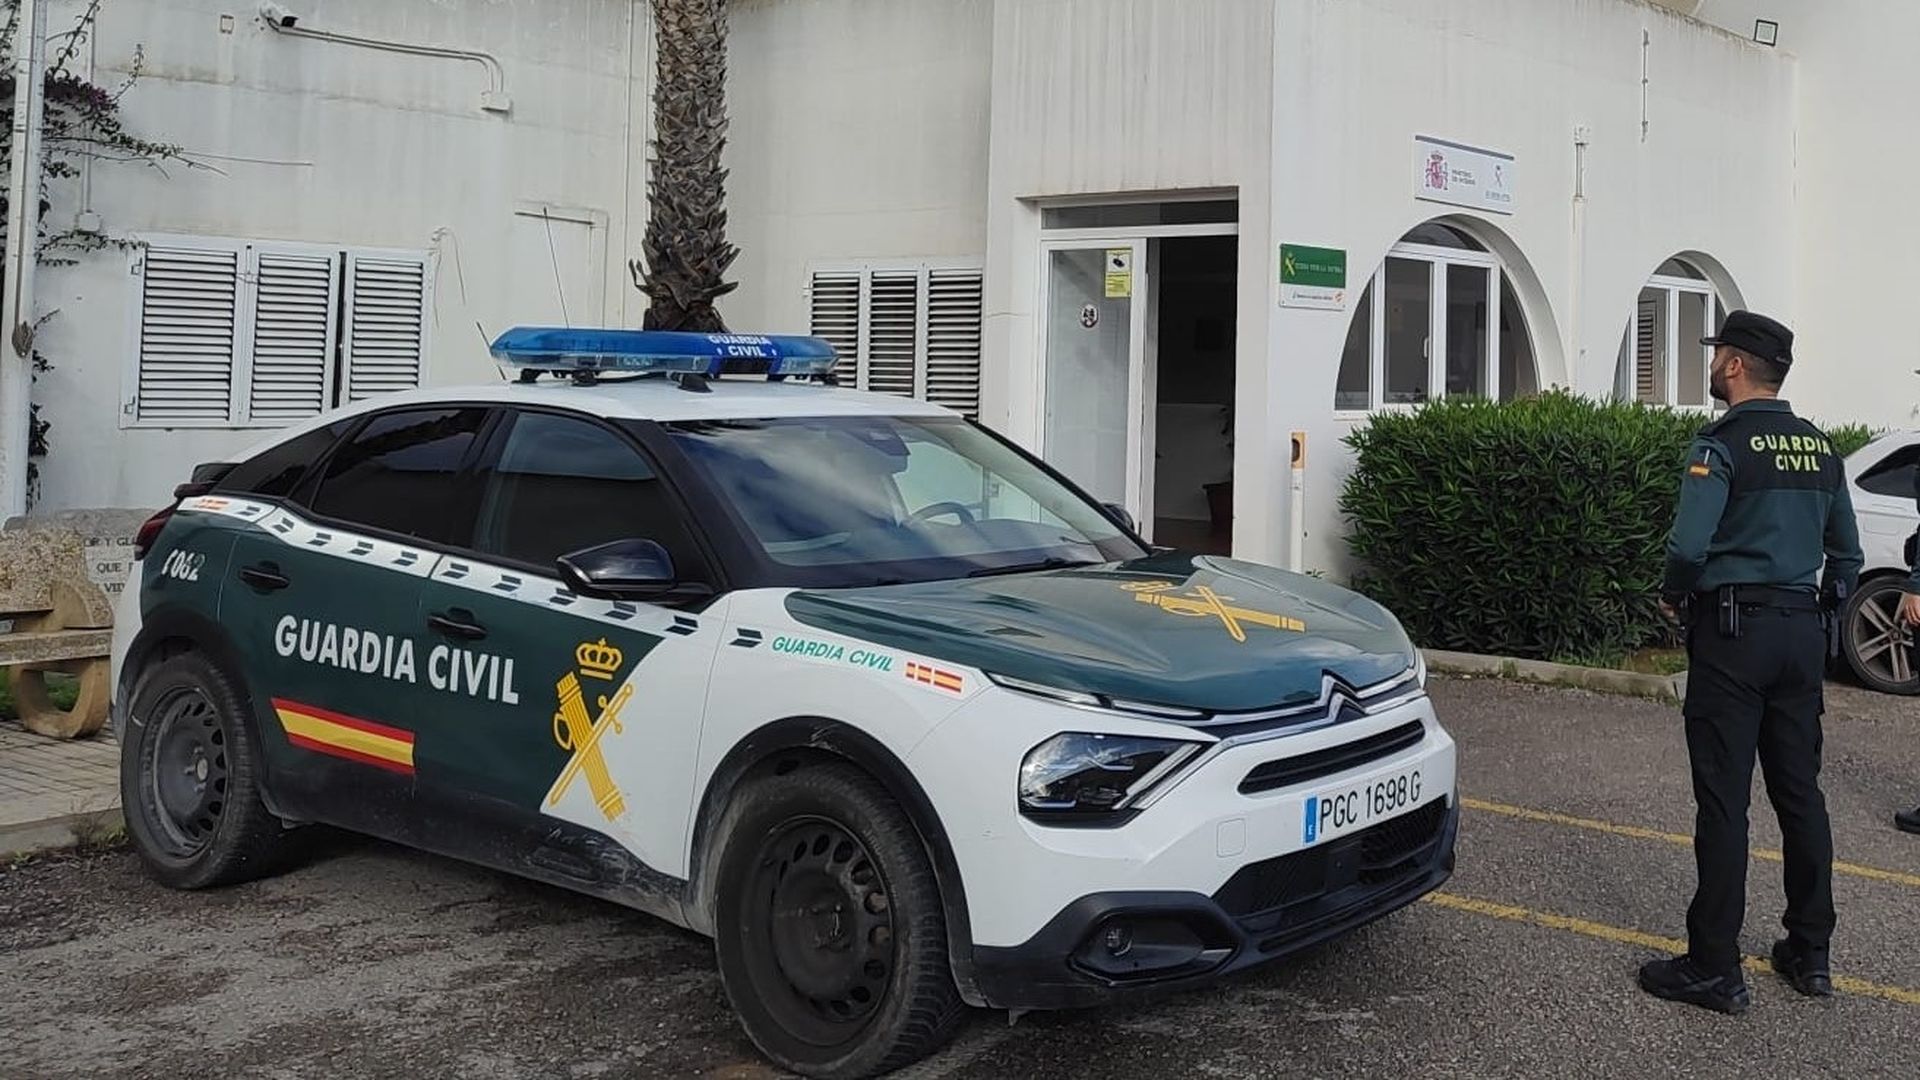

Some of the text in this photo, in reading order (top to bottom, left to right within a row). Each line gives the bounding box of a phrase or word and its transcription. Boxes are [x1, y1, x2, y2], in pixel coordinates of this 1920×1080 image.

[709, 335, 772, 346] GUARDIA
[728, 345, 766, 356] CIVIL
[1751, 435, 1832, 456] GUARDIA
[1775, 455, 1820, 471] CIVIL
[97, 562, 121, 574] QUE
[274, 614, 519, 705] GUARDIA CIVIL
[772, 636, 893, 672] GUARDIA CIVIL
[1320, 790, 1358, 834] PGC
[1365, 775, 1407, 819] 1698
[1410, 770, 1420, 802] G
